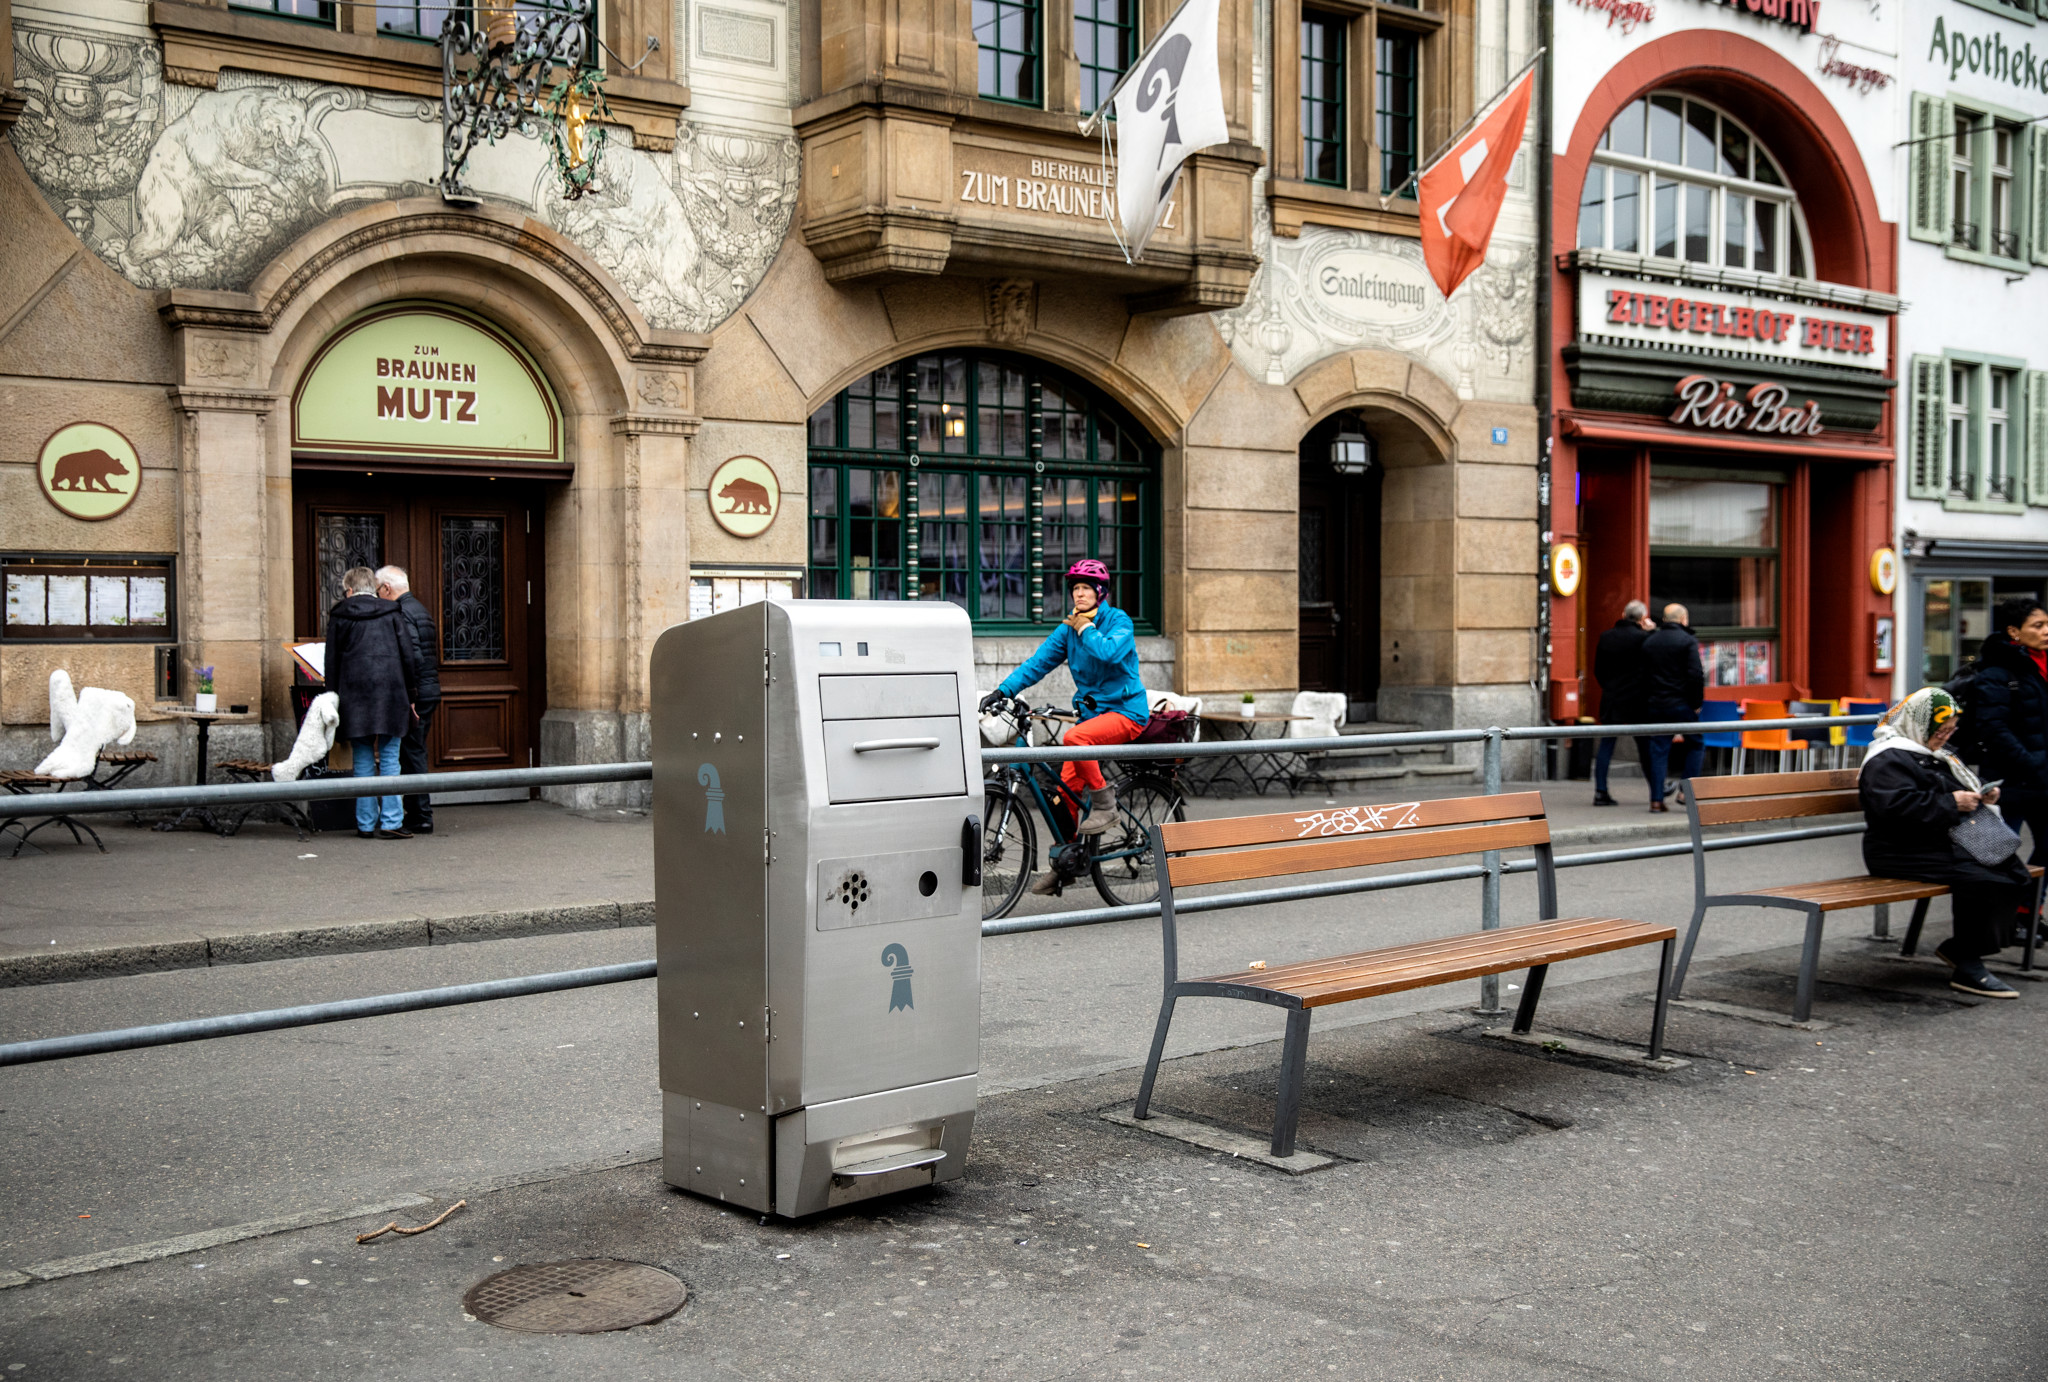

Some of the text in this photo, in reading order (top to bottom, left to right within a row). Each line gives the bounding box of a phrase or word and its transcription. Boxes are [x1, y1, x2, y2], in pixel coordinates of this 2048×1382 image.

[1928, 15, 2048, 95] Apotheke
[961, 170, 1009, 206] ZUM
[1016, 178, 1115, 221] BRAUNEN
[1031, 159, 1115, 187] BIERHALLE
[1320, 266, 1426, 312] Saaleingang
[1607, 289, 1874, 353] ZIEGELHOF BIER
[376, 357, 477, 384] BRAUNEN
[414, 345, 440, 356] ZUM
[377, 385, 478, 424] MUTZ
[1670, 374, 1824, 436] Rio Bar
